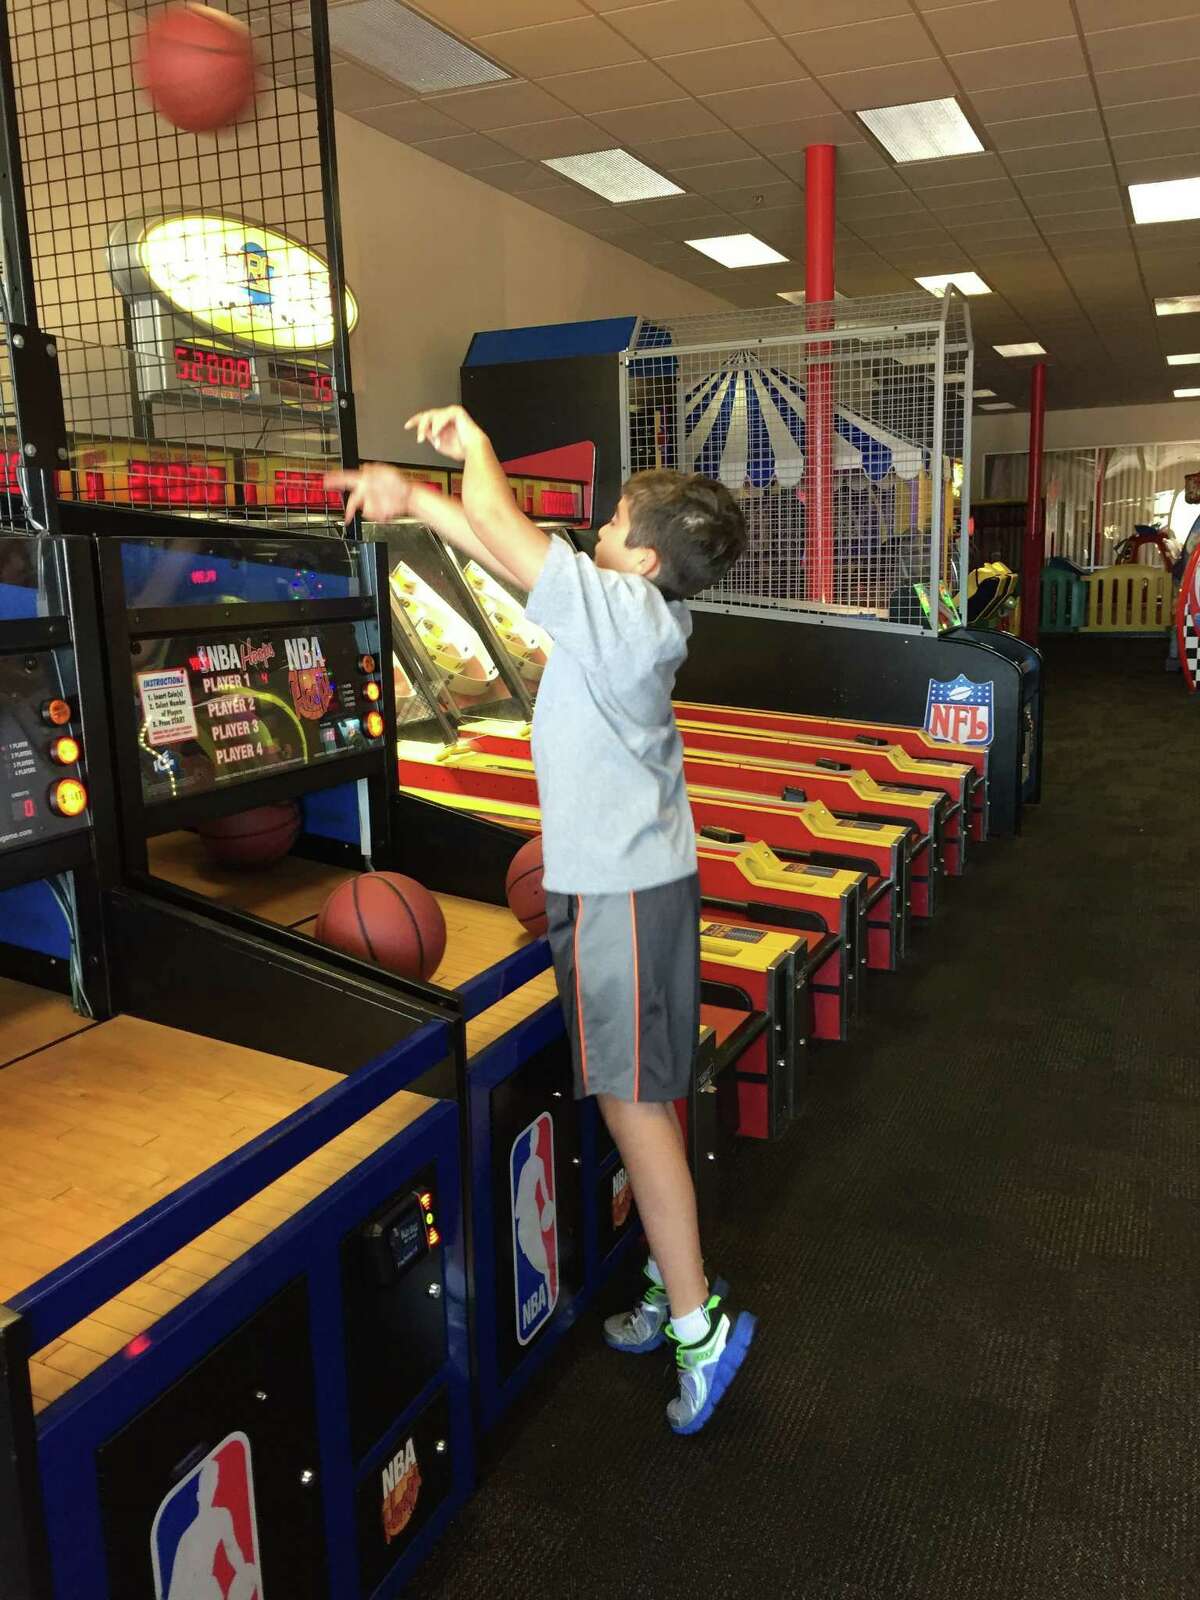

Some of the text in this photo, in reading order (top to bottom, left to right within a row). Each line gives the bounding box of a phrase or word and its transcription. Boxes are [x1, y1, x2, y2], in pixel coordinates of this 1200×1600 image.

[207, 644, 241, 672] NBA
[284, 636, 326, 671] NBA
[203, 672, 251, 693] PLAYER 1
[208, 697, 256, 717] PLAYER 2
[212, 721, 250, 741] PLAYER
[252, 719, 259, 733] 3
[930, 704, 987, 743] NFL
[216, 741, 263, 764] PLAYER 4
[523, 1283, 546, 1330] NBA
[382, 1438, 417, 1499] NBA
